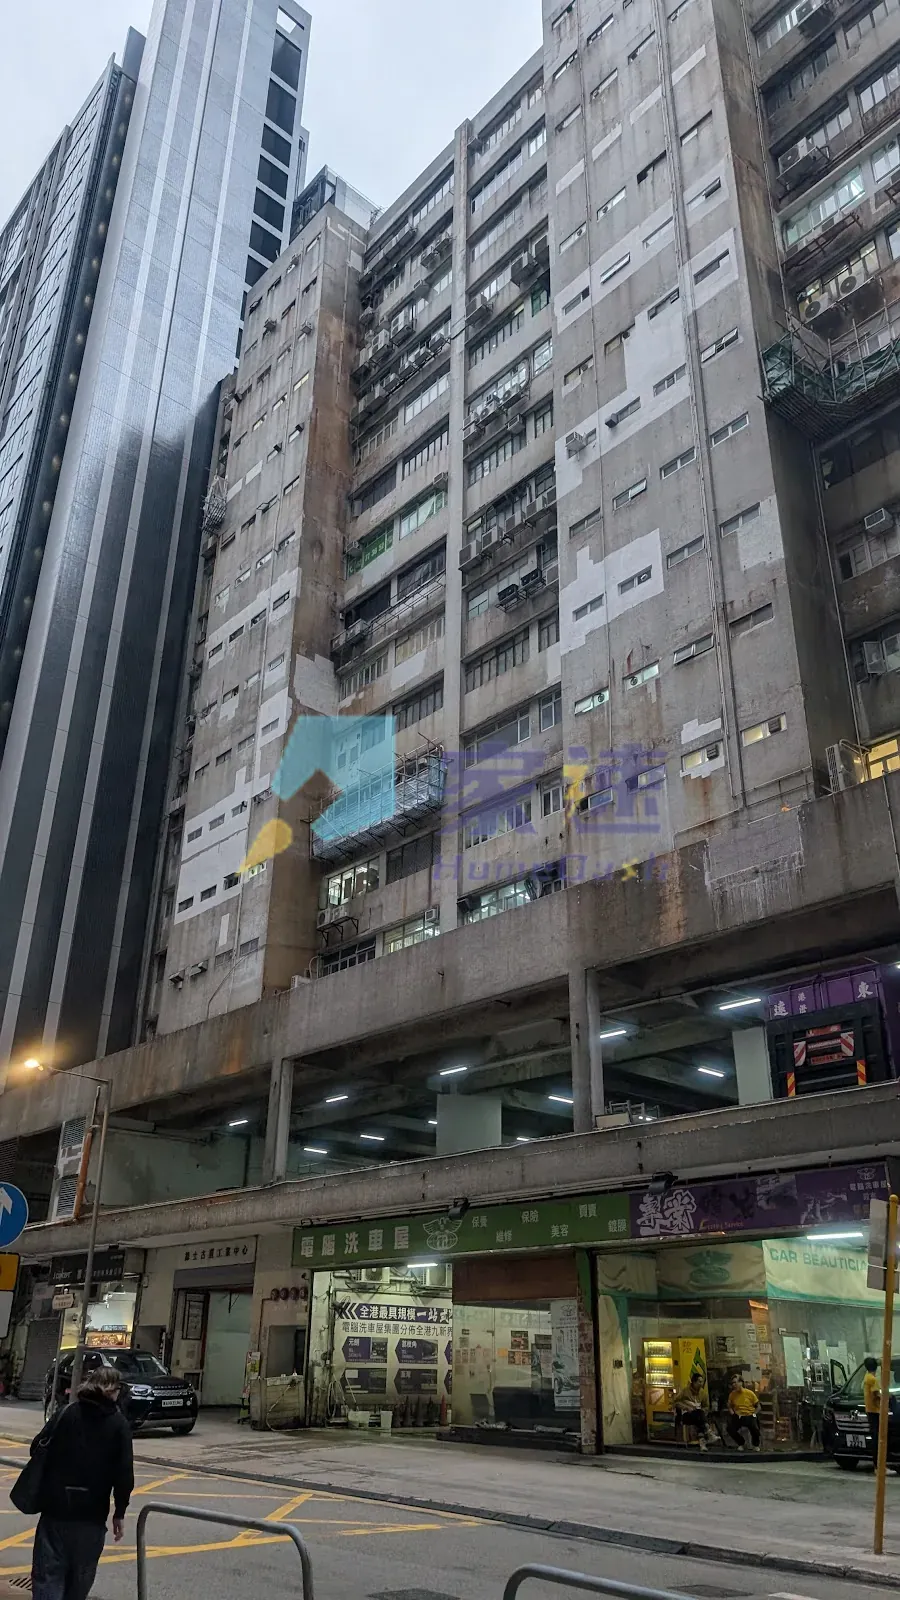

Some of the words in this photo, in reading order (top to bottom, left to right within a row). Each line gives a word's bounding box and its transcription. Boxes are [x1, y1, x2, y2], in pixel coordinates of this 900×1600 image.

[521, 1209, 539, 1224] 保險
[550, 1224, 569, 1238] 美容
[300, 1225, 410, 1259] 電腦洗車屋
[769, 1248, 798, 1263] CAR
[359, 1305, 452, 1324] 全港最具規模一站式
